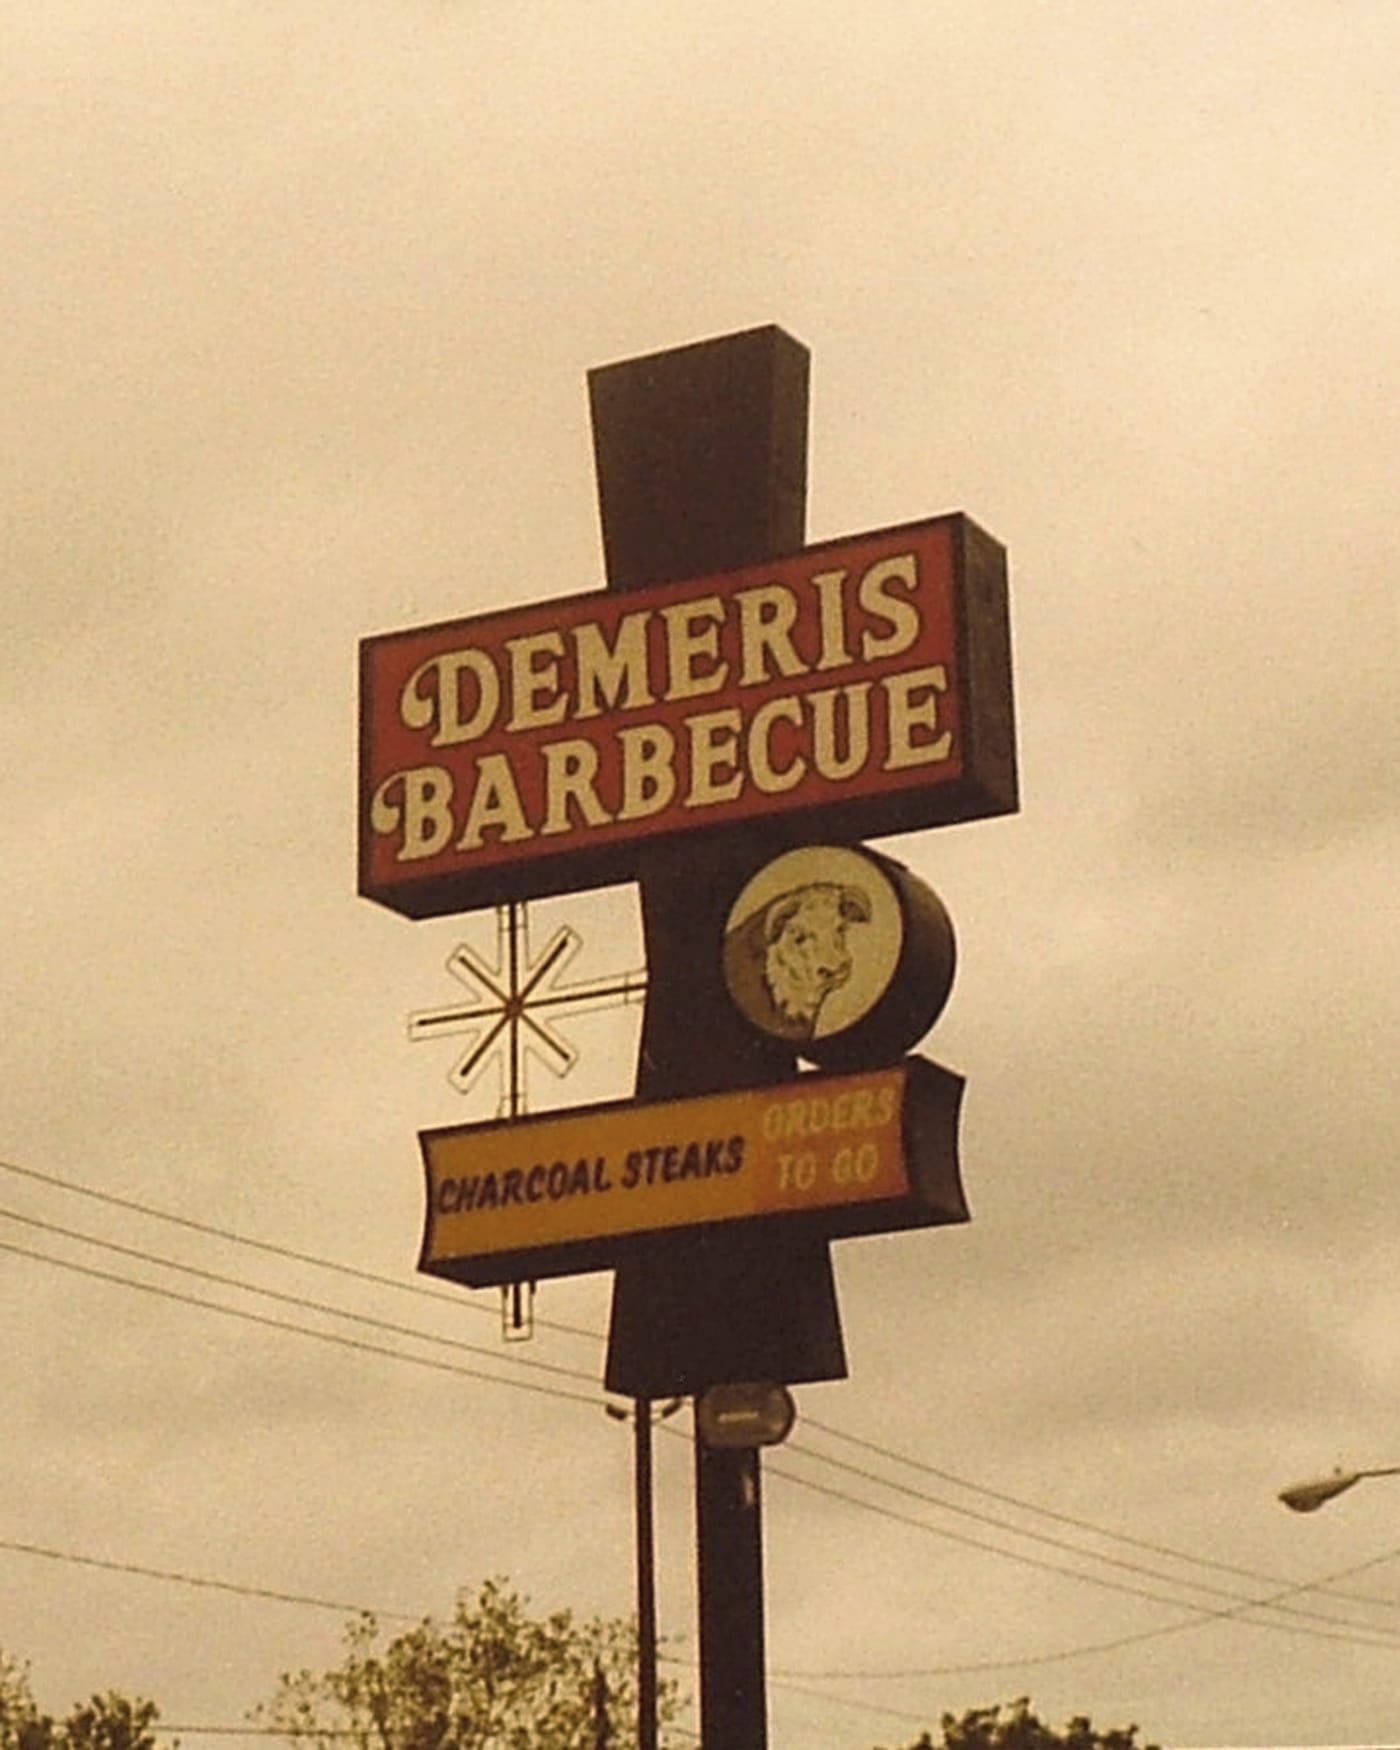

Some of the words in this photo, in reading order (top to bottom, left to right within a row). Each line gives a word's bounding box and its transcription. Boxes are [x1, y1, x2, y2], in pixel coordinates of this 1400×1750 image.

[401, 554, 921, 747] DEMERIS
[370, 665, 954, 862] BARBECUE
[764, 1087, 894, 1141] ORDERS
[438, 1157, 611, 1215] CHARCOAL
[621, 1136, 745, 1189] STEAKS
[778, 1154, 816, 1190] TO
[833, 1143, 879, 1185] GO
